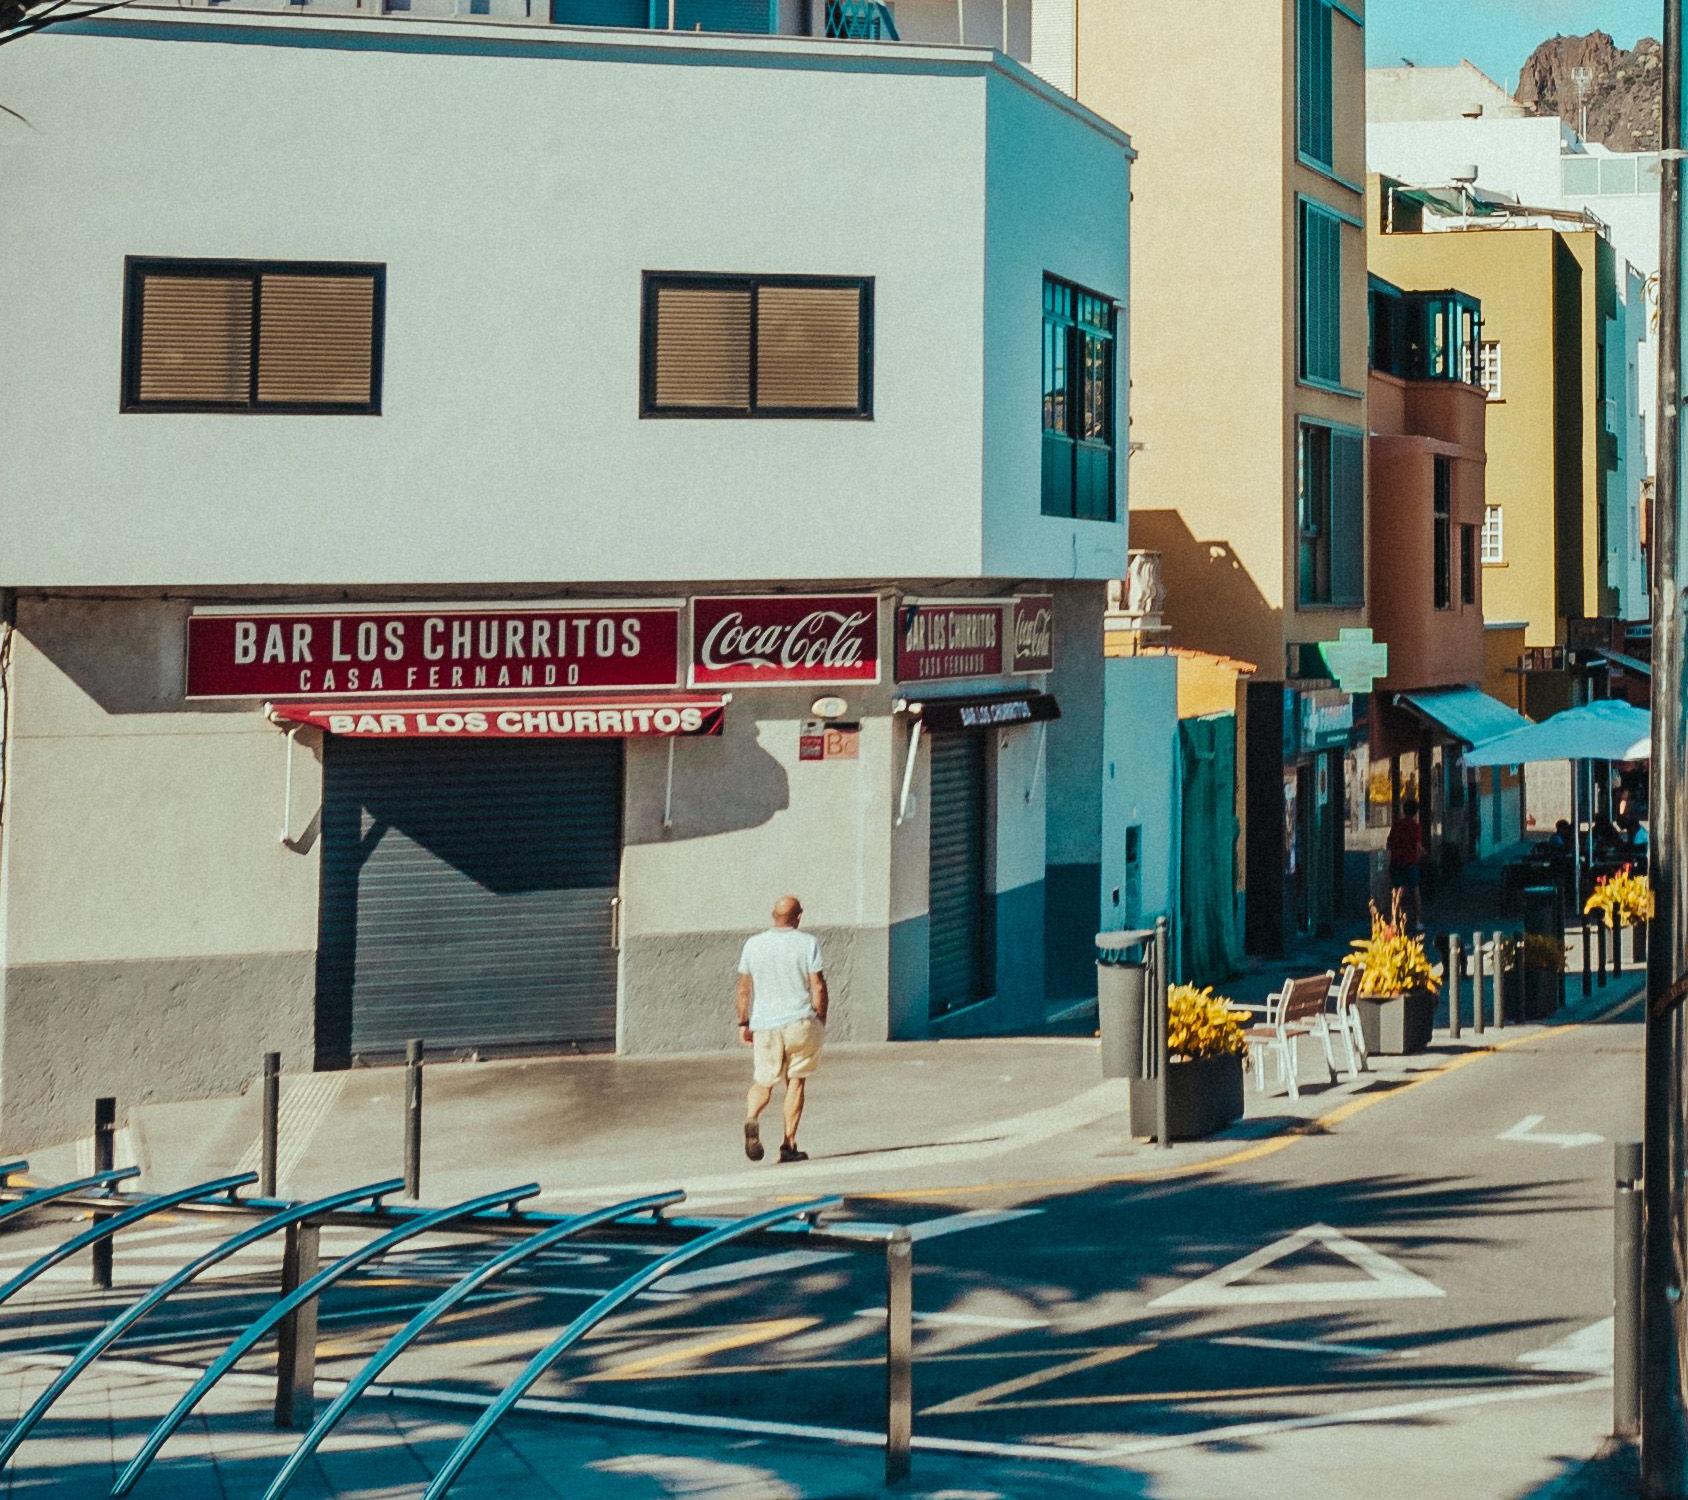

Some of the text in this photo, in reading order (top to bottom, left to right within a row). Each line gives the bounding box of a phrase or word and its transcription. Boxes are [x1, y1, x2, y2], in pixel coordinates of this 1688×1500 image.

[234, 617, 641, 664] BAR LOS CHURRITOS
[300, 664, 579, 690] CASA FERNANDO
[329, 708, 702, 734] BAR LOS CHURRITOS
